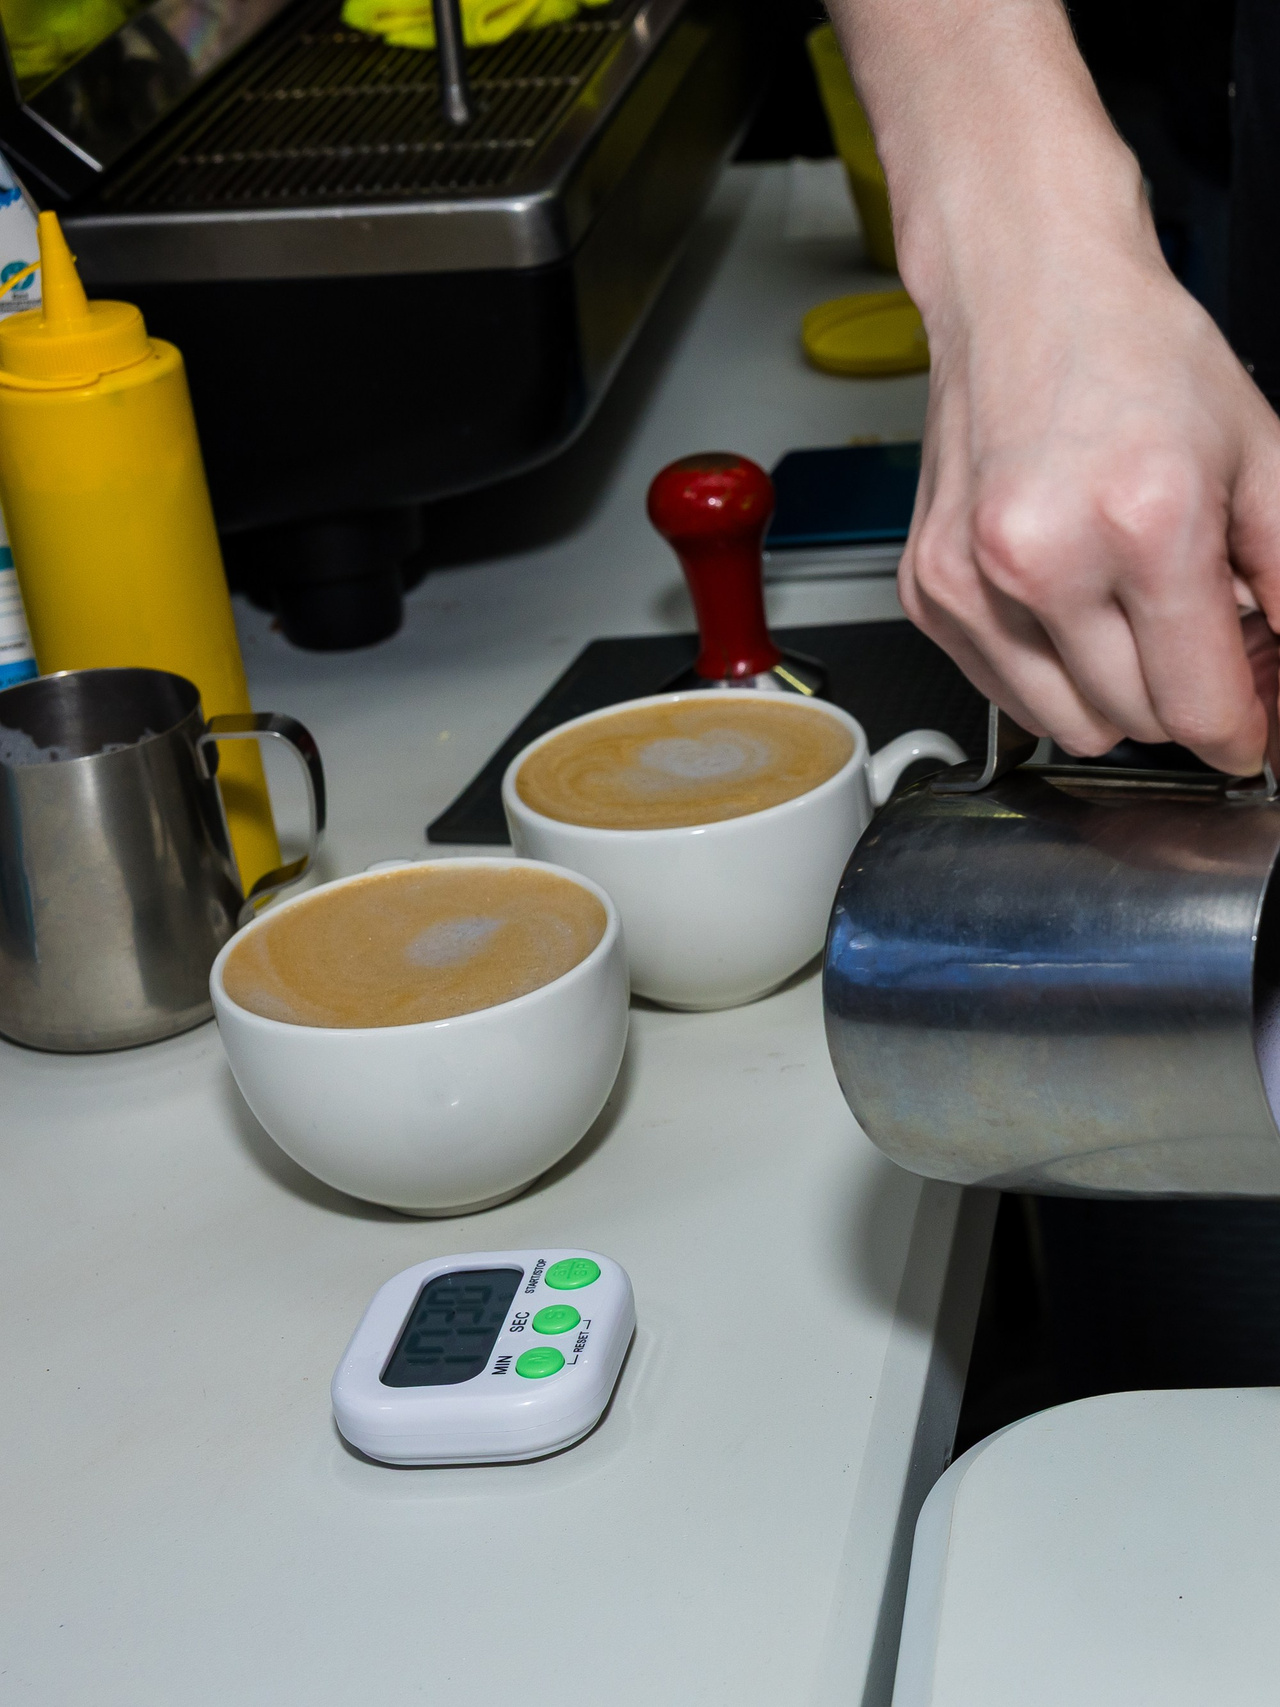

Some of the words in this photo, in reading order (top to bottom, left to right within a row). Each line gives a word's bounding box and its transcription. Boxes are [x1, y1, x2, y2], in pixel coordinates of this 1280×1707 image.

[525, 1259, 547, 1294] START/STOP
[510, 1311, 530, 1332] SEC
[573, 1331, 589, 1353] RESET
[491, 1355, 513, 1375] MIN
